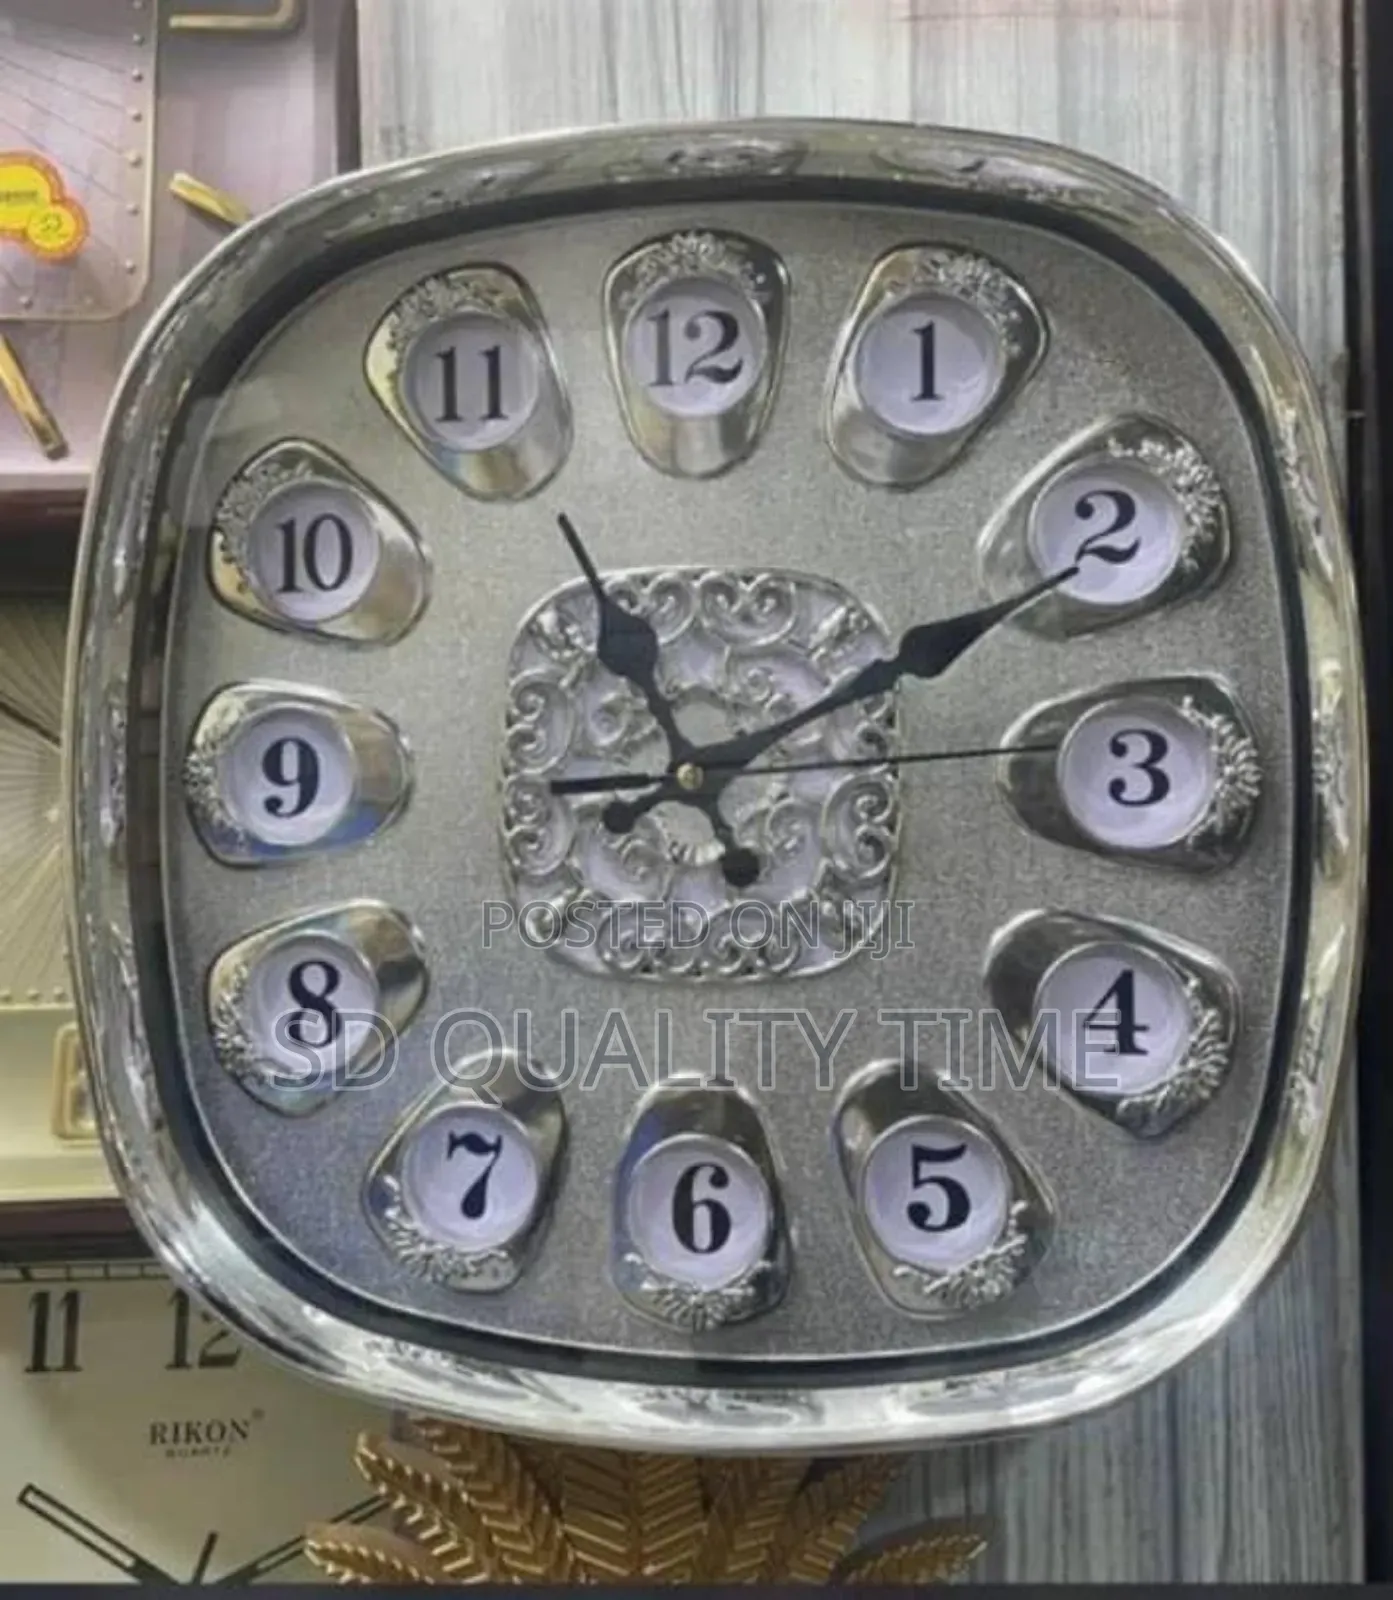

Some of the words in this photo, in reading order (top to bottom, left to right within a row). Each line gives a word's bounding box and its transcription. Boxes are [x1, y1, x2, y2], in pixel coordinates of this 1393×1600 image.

[433, 345, 509, 423] 11
[647, 307, 744, 386] 12
[910, 321, 943, 401] 1
[277, 513, 353, 593] 10
[1073, 489, 1141, 565] 2
[261, 736, 320, 817] 9
[1108, 728, 1171, 808] 3
[287, 960, 342, 1047] 8
[1082, 968, 1150, 1055] 4
[447, 1131, 502, 1220] 7
[672, 1161, 732, 1254] 6
[906, 1142, 972, 1233] 5
[24, 1289, 83, 1373] 11
[150, 1418, 250, 1446] RIKON
